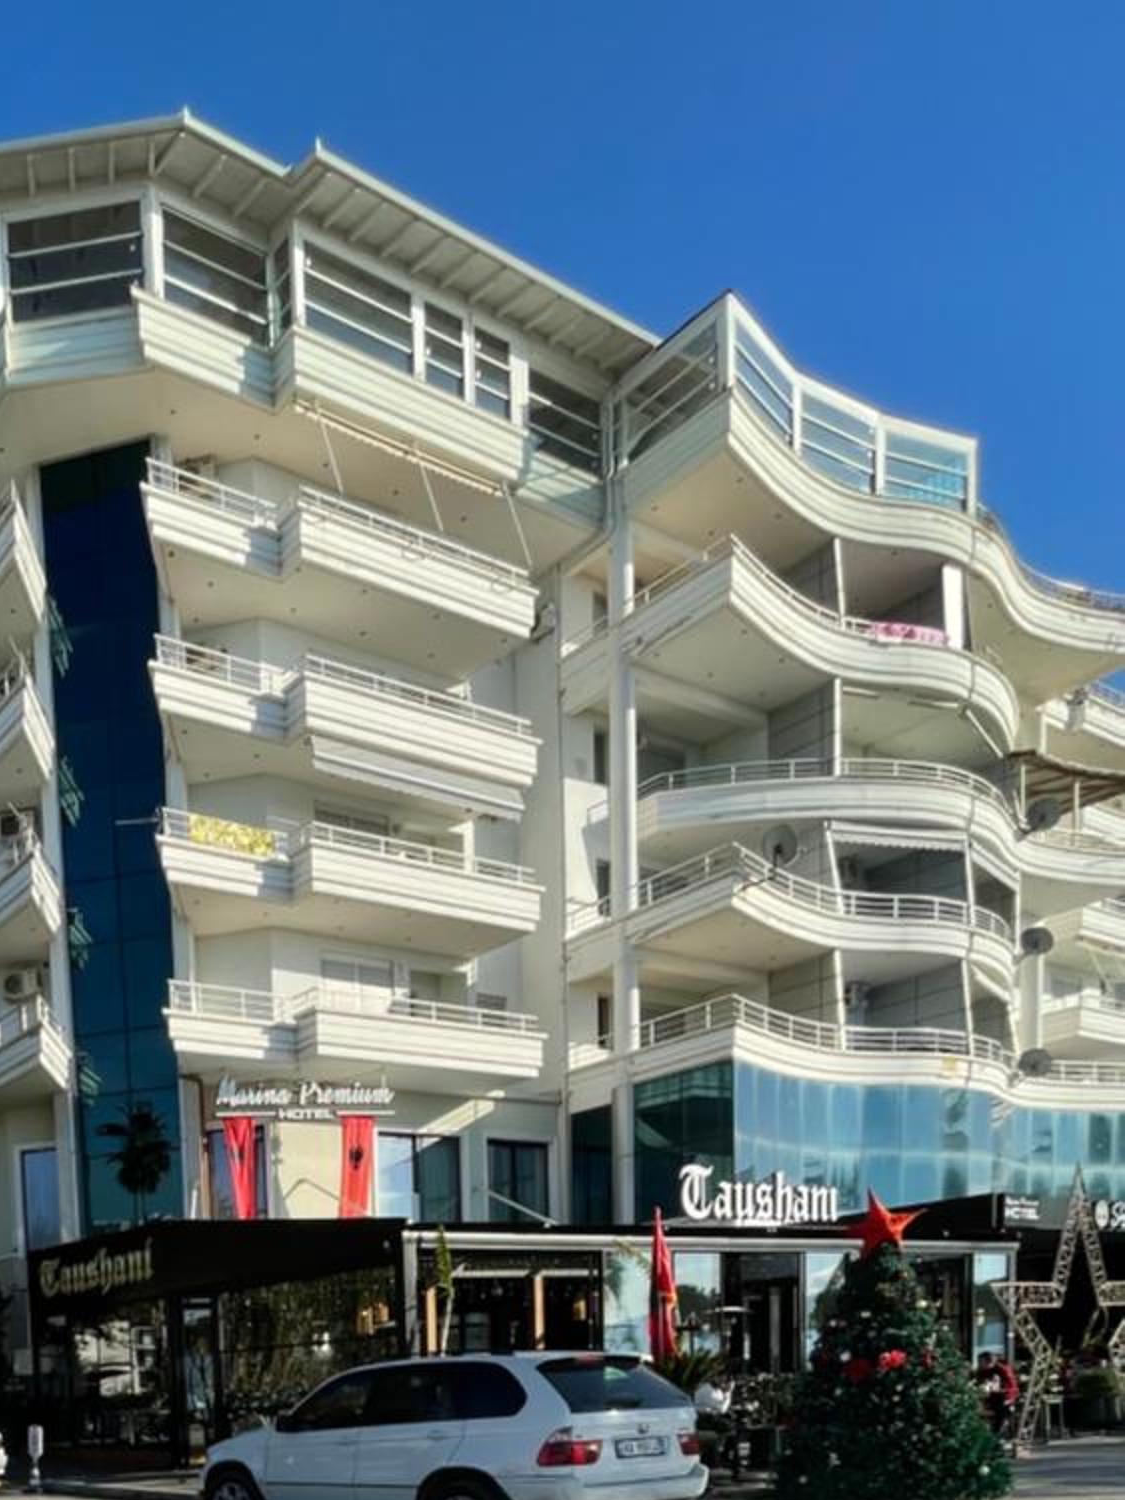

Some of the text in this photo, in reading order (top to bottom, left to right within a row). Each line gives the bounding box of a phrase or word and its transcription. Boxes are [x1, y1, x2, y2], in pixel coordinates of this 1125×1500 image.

[216, 1076, 395, 1106] Marina Premium
[277, 1108, 335, 1120] HOTEL
